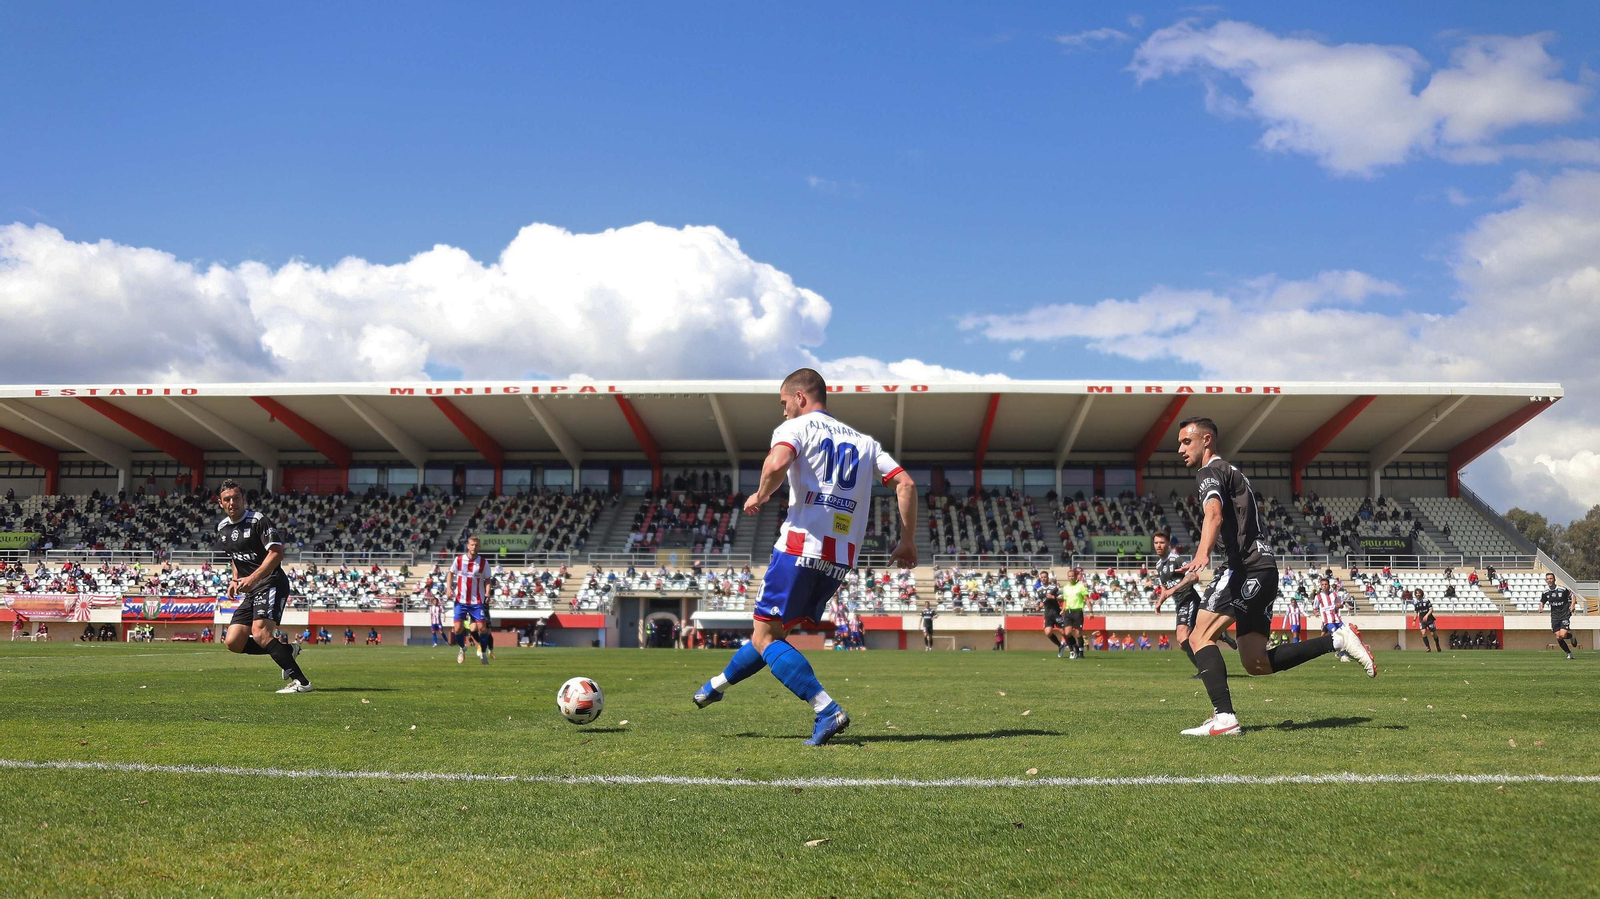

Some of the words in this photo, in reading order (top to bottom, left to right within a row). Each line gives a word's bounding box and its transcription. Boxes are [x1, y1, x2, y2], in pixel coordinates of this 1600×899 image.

[34, 388, 198, 397] ESTADIO
[389, 385, 623, 395] MUNICIPAL
[826, 384, 929, 393] UEVO
[1087, 385, 1281, 394] MIRADOR
[809, 420, 862, 438] ALMENARA
[820, 437, 859, 491] 10
